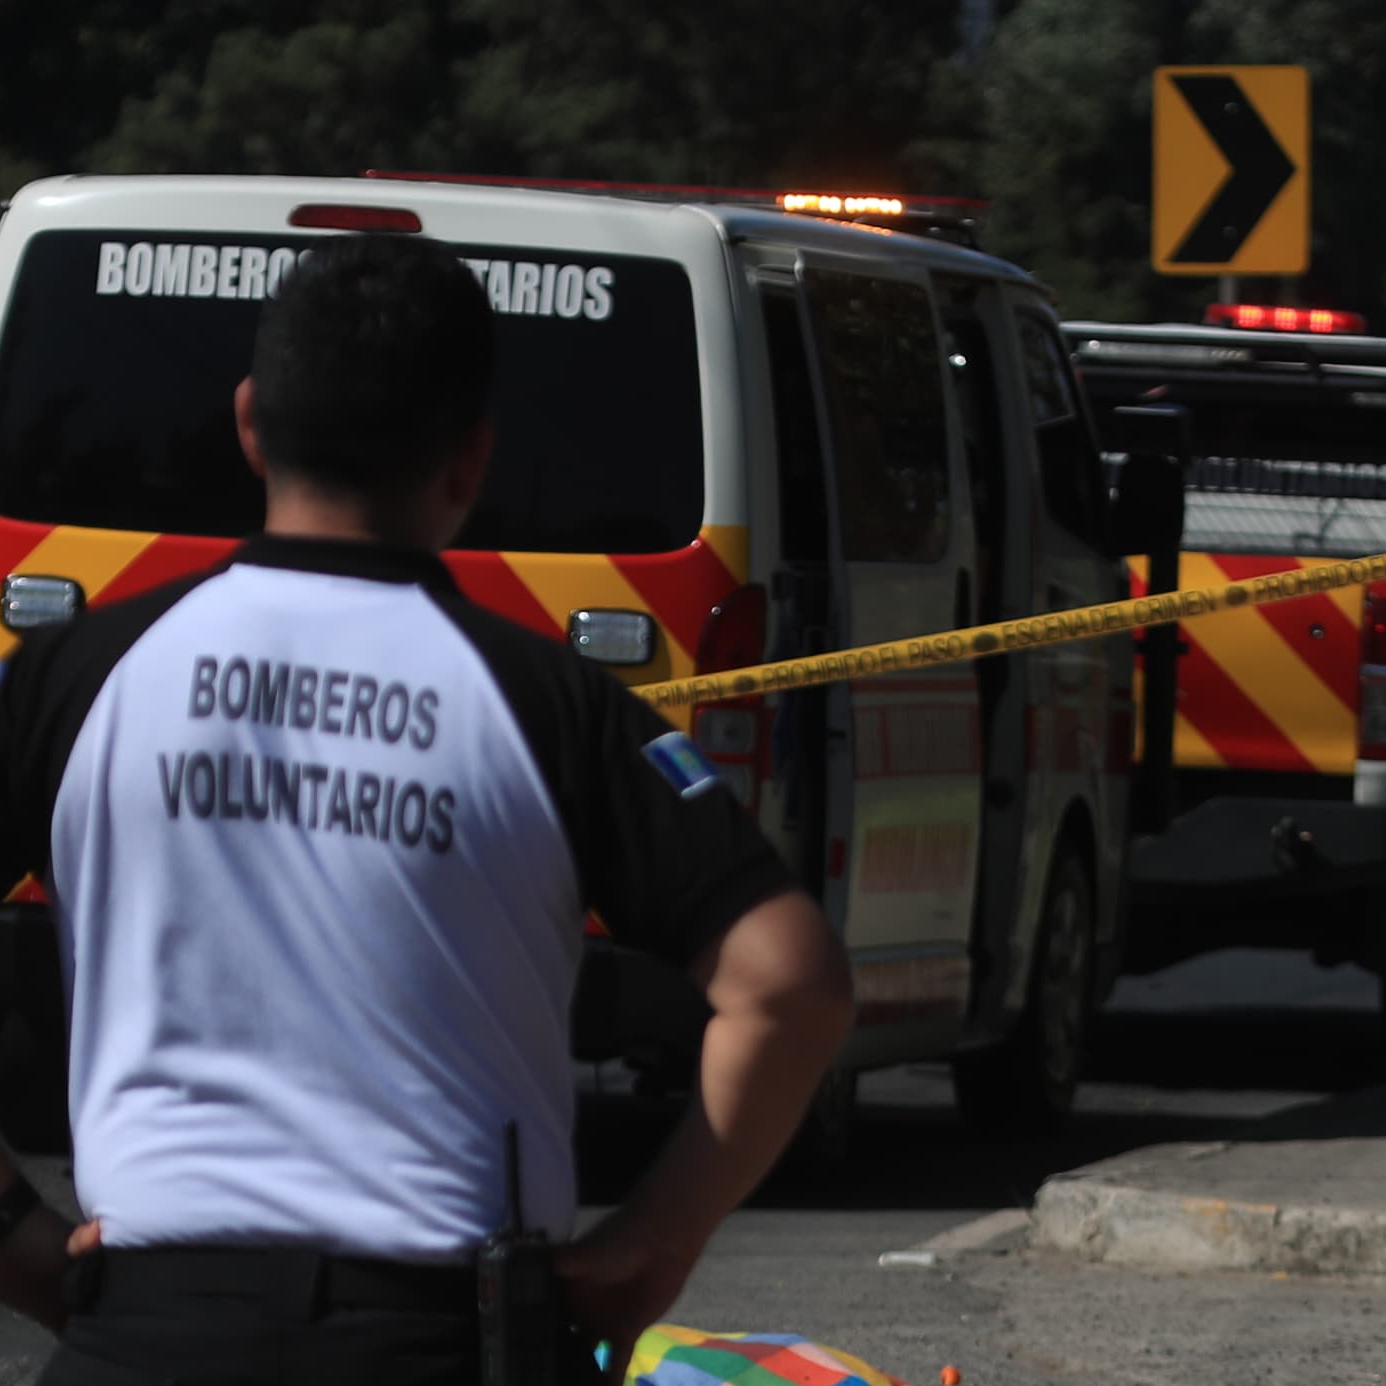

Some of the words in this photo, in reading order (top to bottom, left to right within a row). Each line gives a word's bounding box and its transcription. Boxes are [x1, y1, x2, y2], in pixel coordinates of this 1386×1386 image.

[96, 240, 314, 301] BOMBERO
[456, 255, 616, 321] TARIOS
[907, 634, 964, 666] PASO
[1002, 611, 1089, 647] ESCENA
[1090, 604, 1126, 633] DEL
[1133, 589, 1216, 624] CRIMEN
[1253, 559, 1367, 596] PROHIBIDO
[187, 655, 440, 752] BOMBEROS
[156, 751, 456, 855] VOLUNTARIOS
